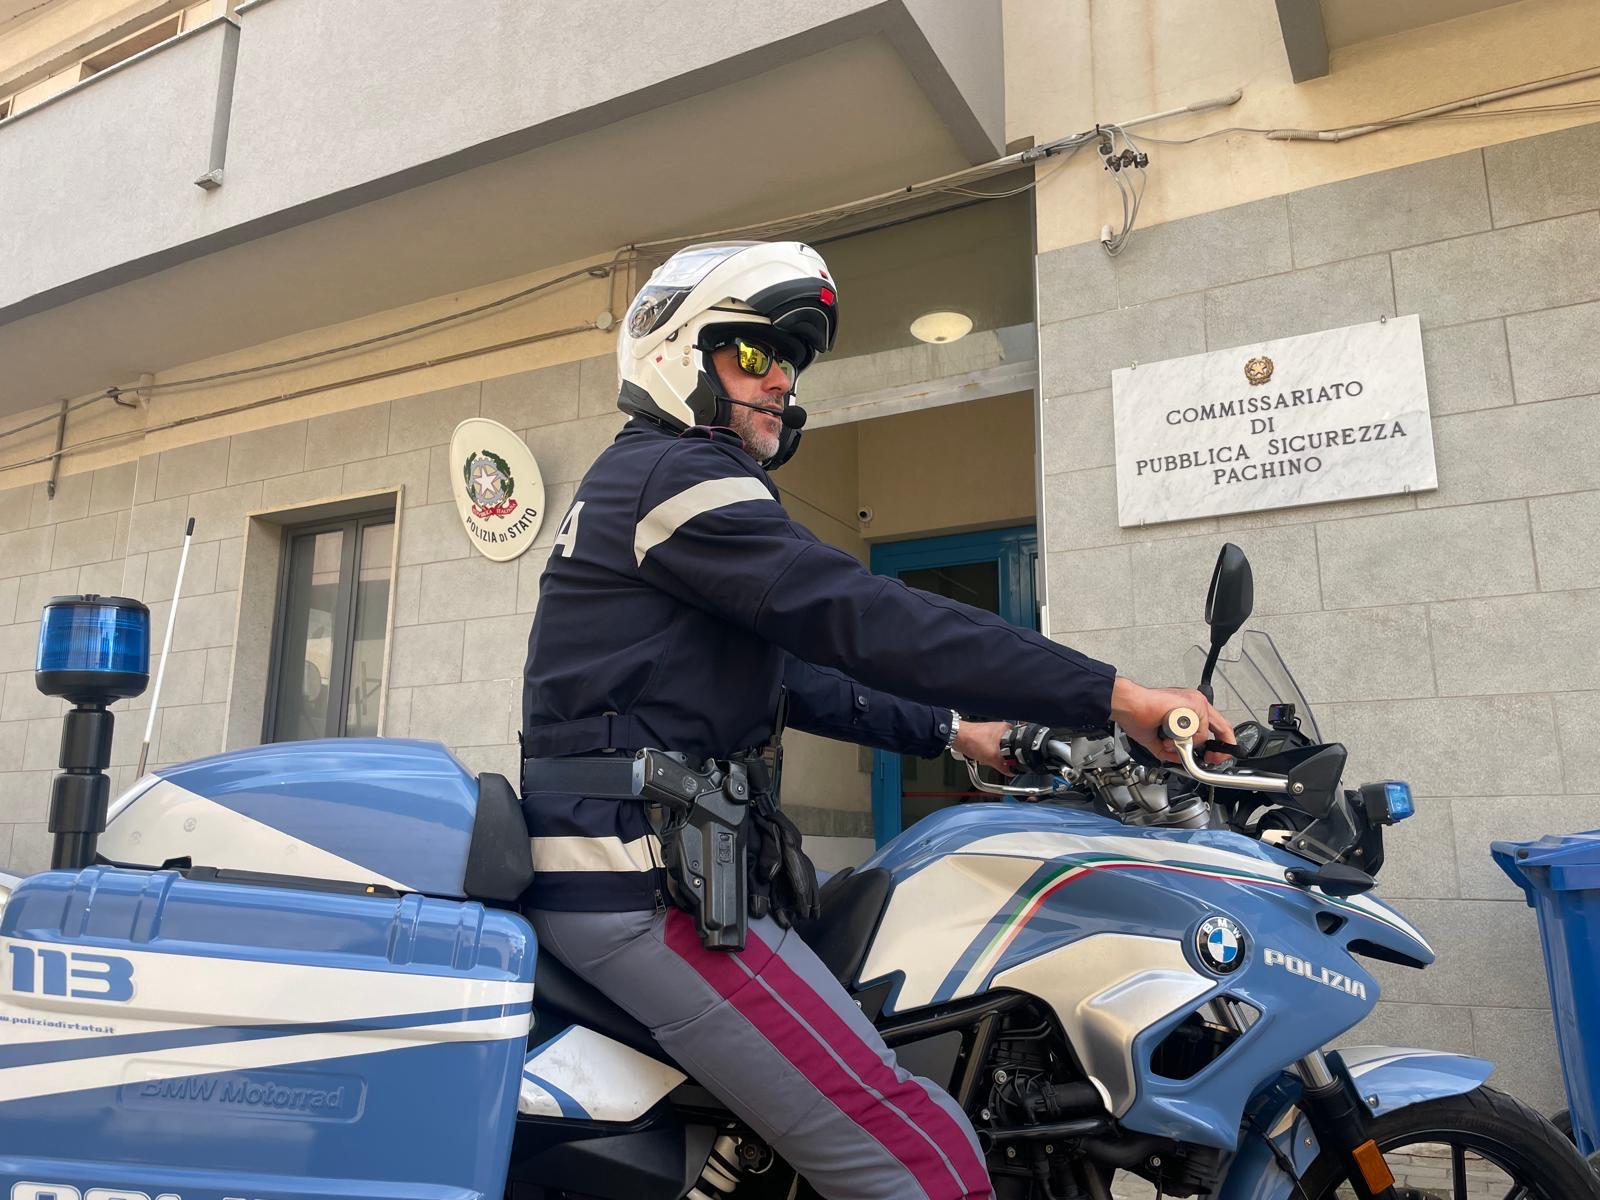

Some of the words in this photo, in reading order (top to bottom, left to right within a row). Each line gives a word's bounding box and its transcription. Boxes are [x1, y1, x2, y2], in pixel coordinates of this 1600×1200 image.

[1166, 380, 1364, 425] COMMISSARIATO
[1250, 416, 1275, 435] DI
[1135, 443, 1251, 476] PUBBLICA
[1267, 420, 1407, 456] SICUREZZA
[1213, 456, 1323, 486] PACHINO
[466, 516, 498, 543] POLIZIA
[507, 507, 538, 539] STATO
[1202, 917, 1243, 940] BMW
[8, 944, 135, 1002] 113
[1263, 947, 1367, 1001] POLIZIA
[139, 1074, 219, 1101] BMW
[219, 1079, 345, 1110] Motorrad
